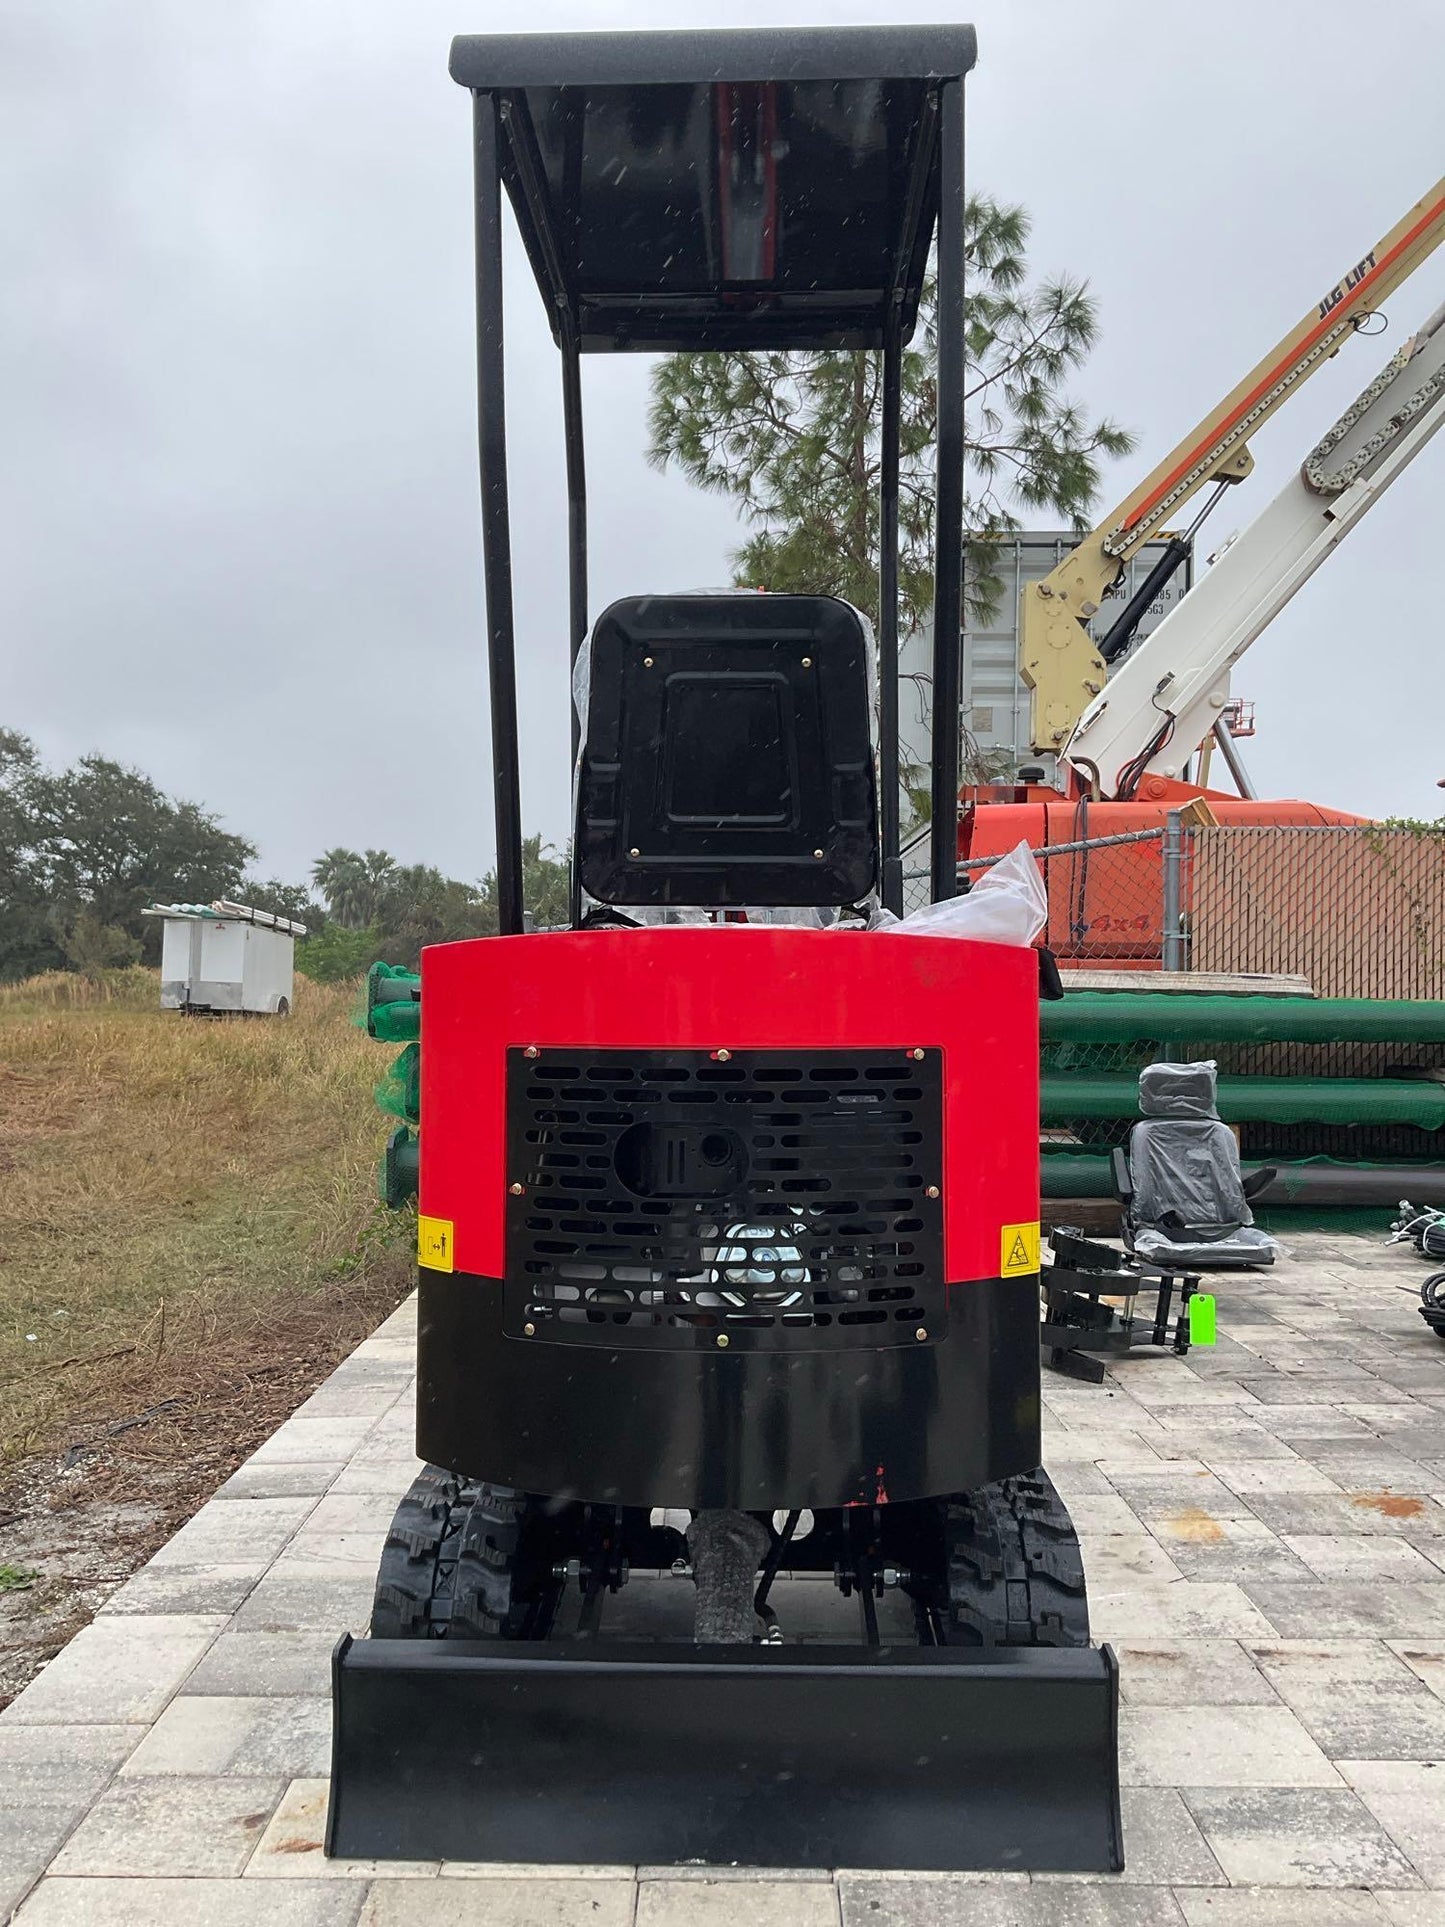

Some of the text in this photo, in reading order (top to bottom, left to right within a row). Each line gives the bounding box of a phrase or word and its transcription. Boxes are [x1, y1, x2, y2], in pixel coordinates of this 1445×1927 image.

[1319, 251, 1376, 320] JLG LIFT
[1146, 604, 1164, 615] 5G3
[1090, 914, 1149, 932] 4x4
